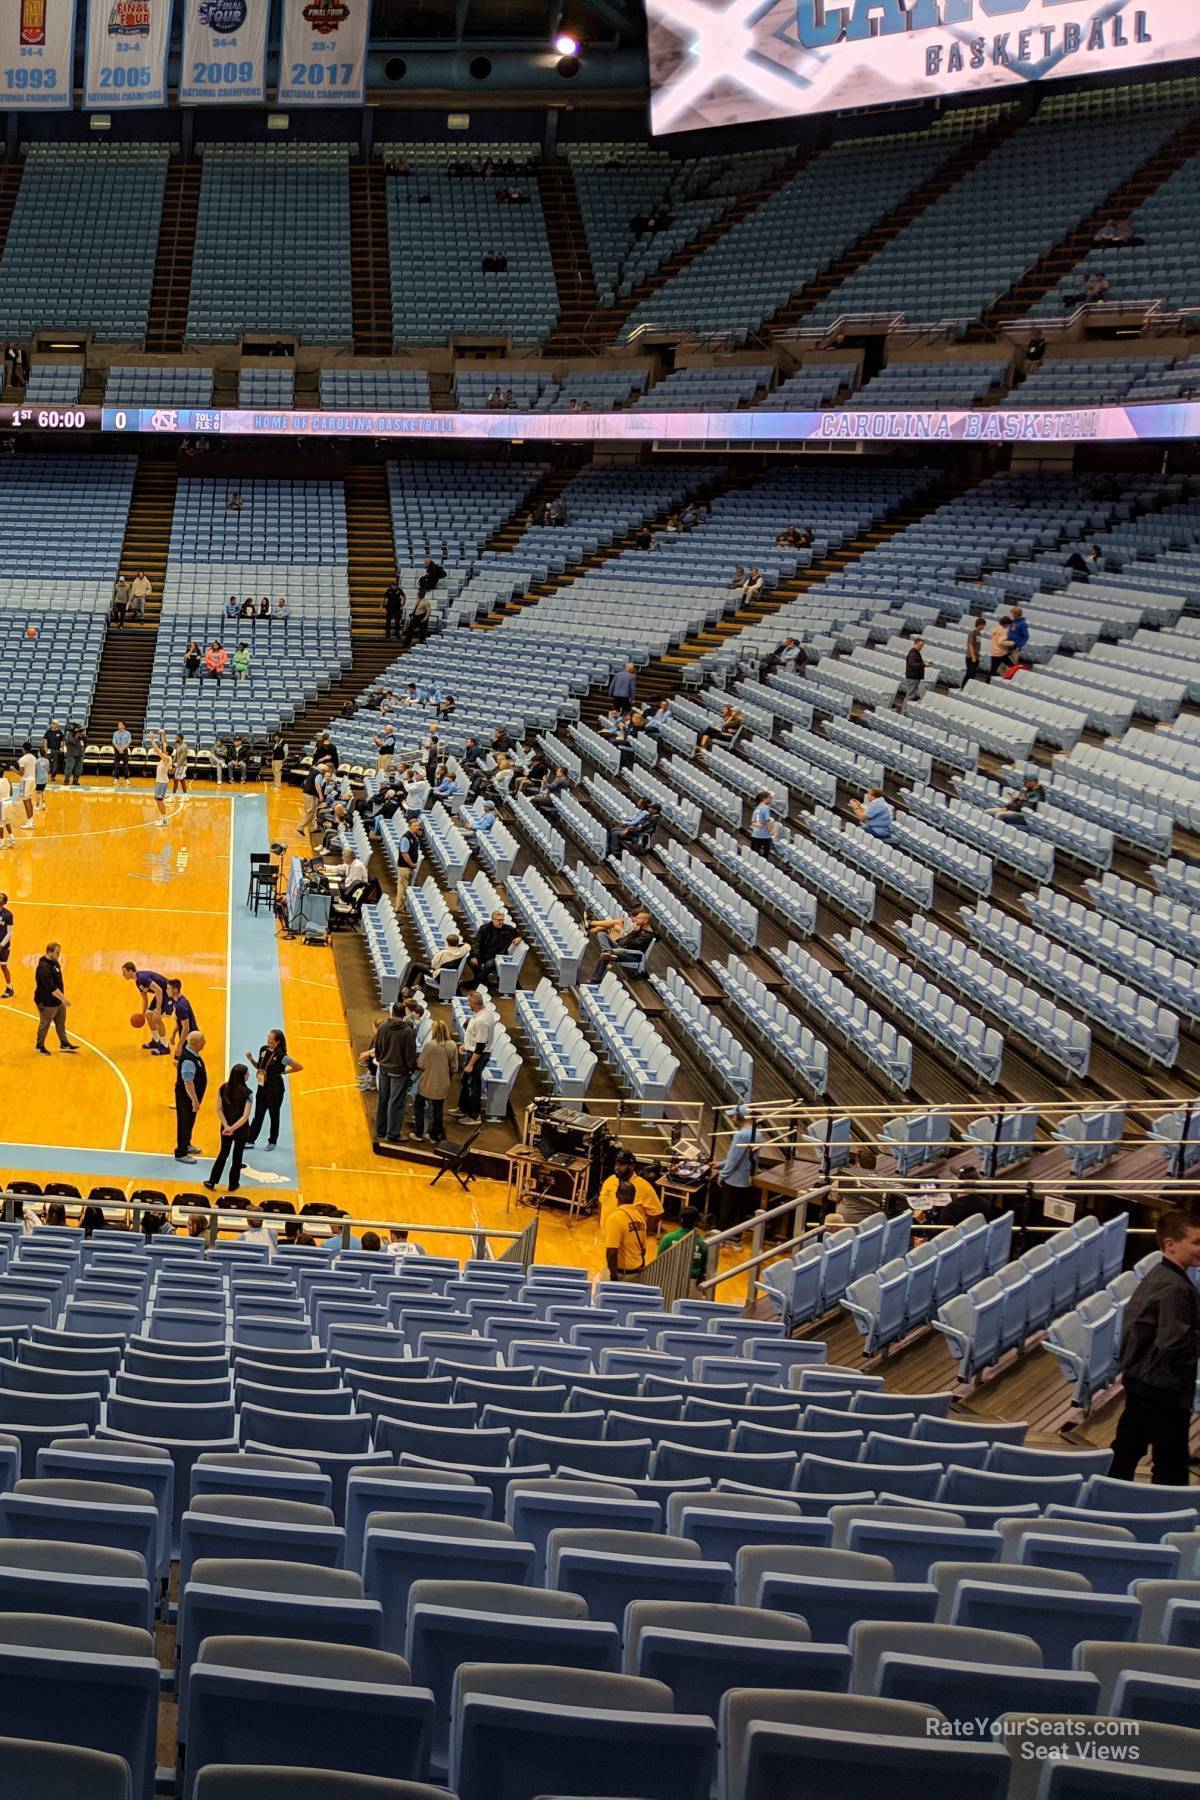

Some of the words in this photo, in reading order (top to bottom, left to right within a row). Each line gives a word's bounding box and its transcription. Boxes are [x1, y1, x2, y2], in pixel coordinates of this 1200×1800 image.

[117, 3, 150, 14] FINAL
[208, 6, 242, 21] FOUR
[925, 10, 1152, 76] BASKETBALL
[4, 68, 57, 89] 1993
[100, 67, 151, 88] 2005
[192, 61, 254, 84] 2009
[291, 63, 354, 85] 2017
[12, 409, 32, 427] 1ST
[38, 410, 86, 428] 60:00
[115, 412, 126, 429] 0
[255, 415, 287, 429] HOME
[312, 416, 373, 431] CAROLINA
[378, 416, 455, 433] BASKETBALL
[820, 413, 953, 439] CAROLINA
